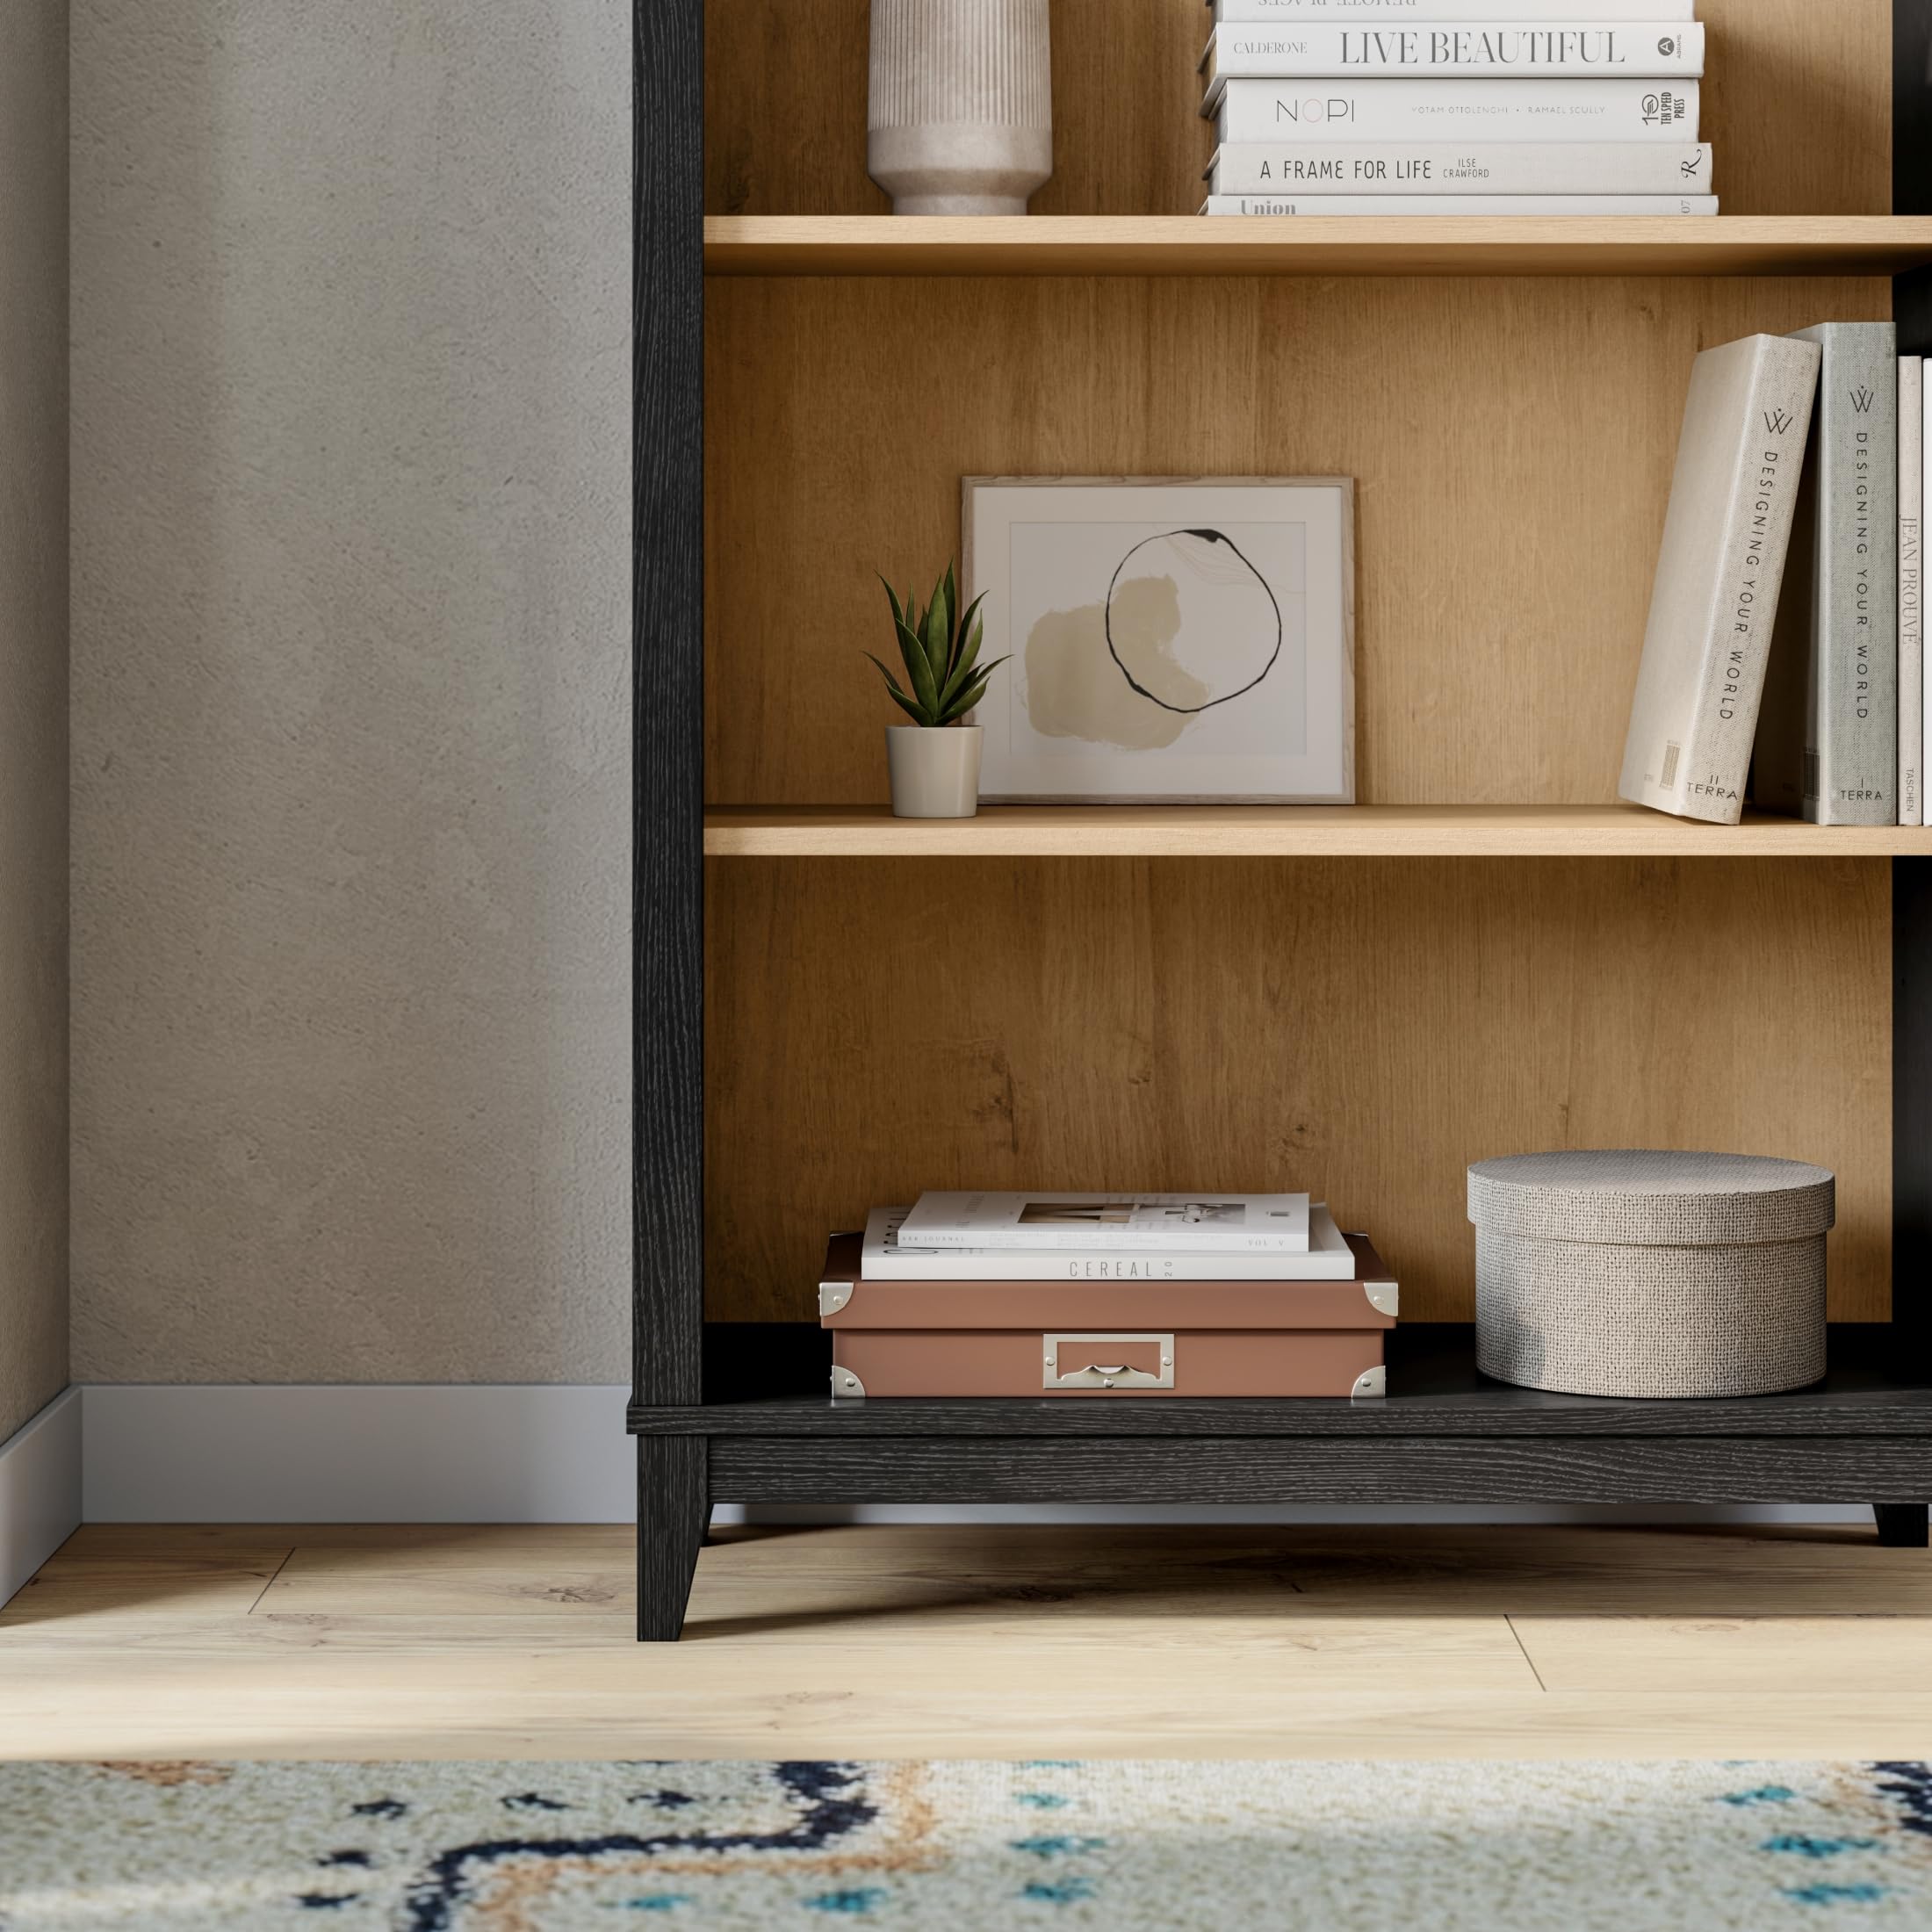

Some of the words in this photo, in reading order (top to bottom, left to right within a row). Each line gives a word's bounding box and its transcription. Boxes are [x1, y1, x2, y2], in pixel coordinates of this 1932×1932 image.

[1233, 41, 1308, 54] CALDERONE
[1339, 32, 1418, 64] LIVE
[1428, 31, 1626, 63] BEAUTIFUL
[1276, 98, 1354, 123] NOPI
[1661, 91, 1672, 112] SPEED
[1674, 98, 1685, 119] PRESS
[1661, 113, 1672, 125] TEN
[1259, 160, 1272, 179] A
[1283, 160, 1344, 179] FRAME
[1354, 160, 1388, 179] FOR
[1396, 160, 1432, 179] LIFE
[1443, 169, 1489, 178] CRAWFORD
[1458, 158, 1476, 168] ILSE
[1680, 148, 1702, 178] R
[1240, 199, 1297, 215] Union
[1856, 432, 1868, 554] DESIGNING
[1746, 451, 1778, 566] DESIGNING
[1899, 514, 1918, 561] JEAN
[1734, 580, 1756, 632] YOUR
[1856, 569, 1868, 625] YOUR
[1719, 651, 1744, 719] WORLD
[1856, 645, 1868, 718] WORLD
[1686, 782, 1739, 801] TERRA
[1840, 789, 1883, 801] TERRA
[1906, 768, 1914, 812] TASCHEN
[1069, 1261, 1152, 1277] CEREAL
